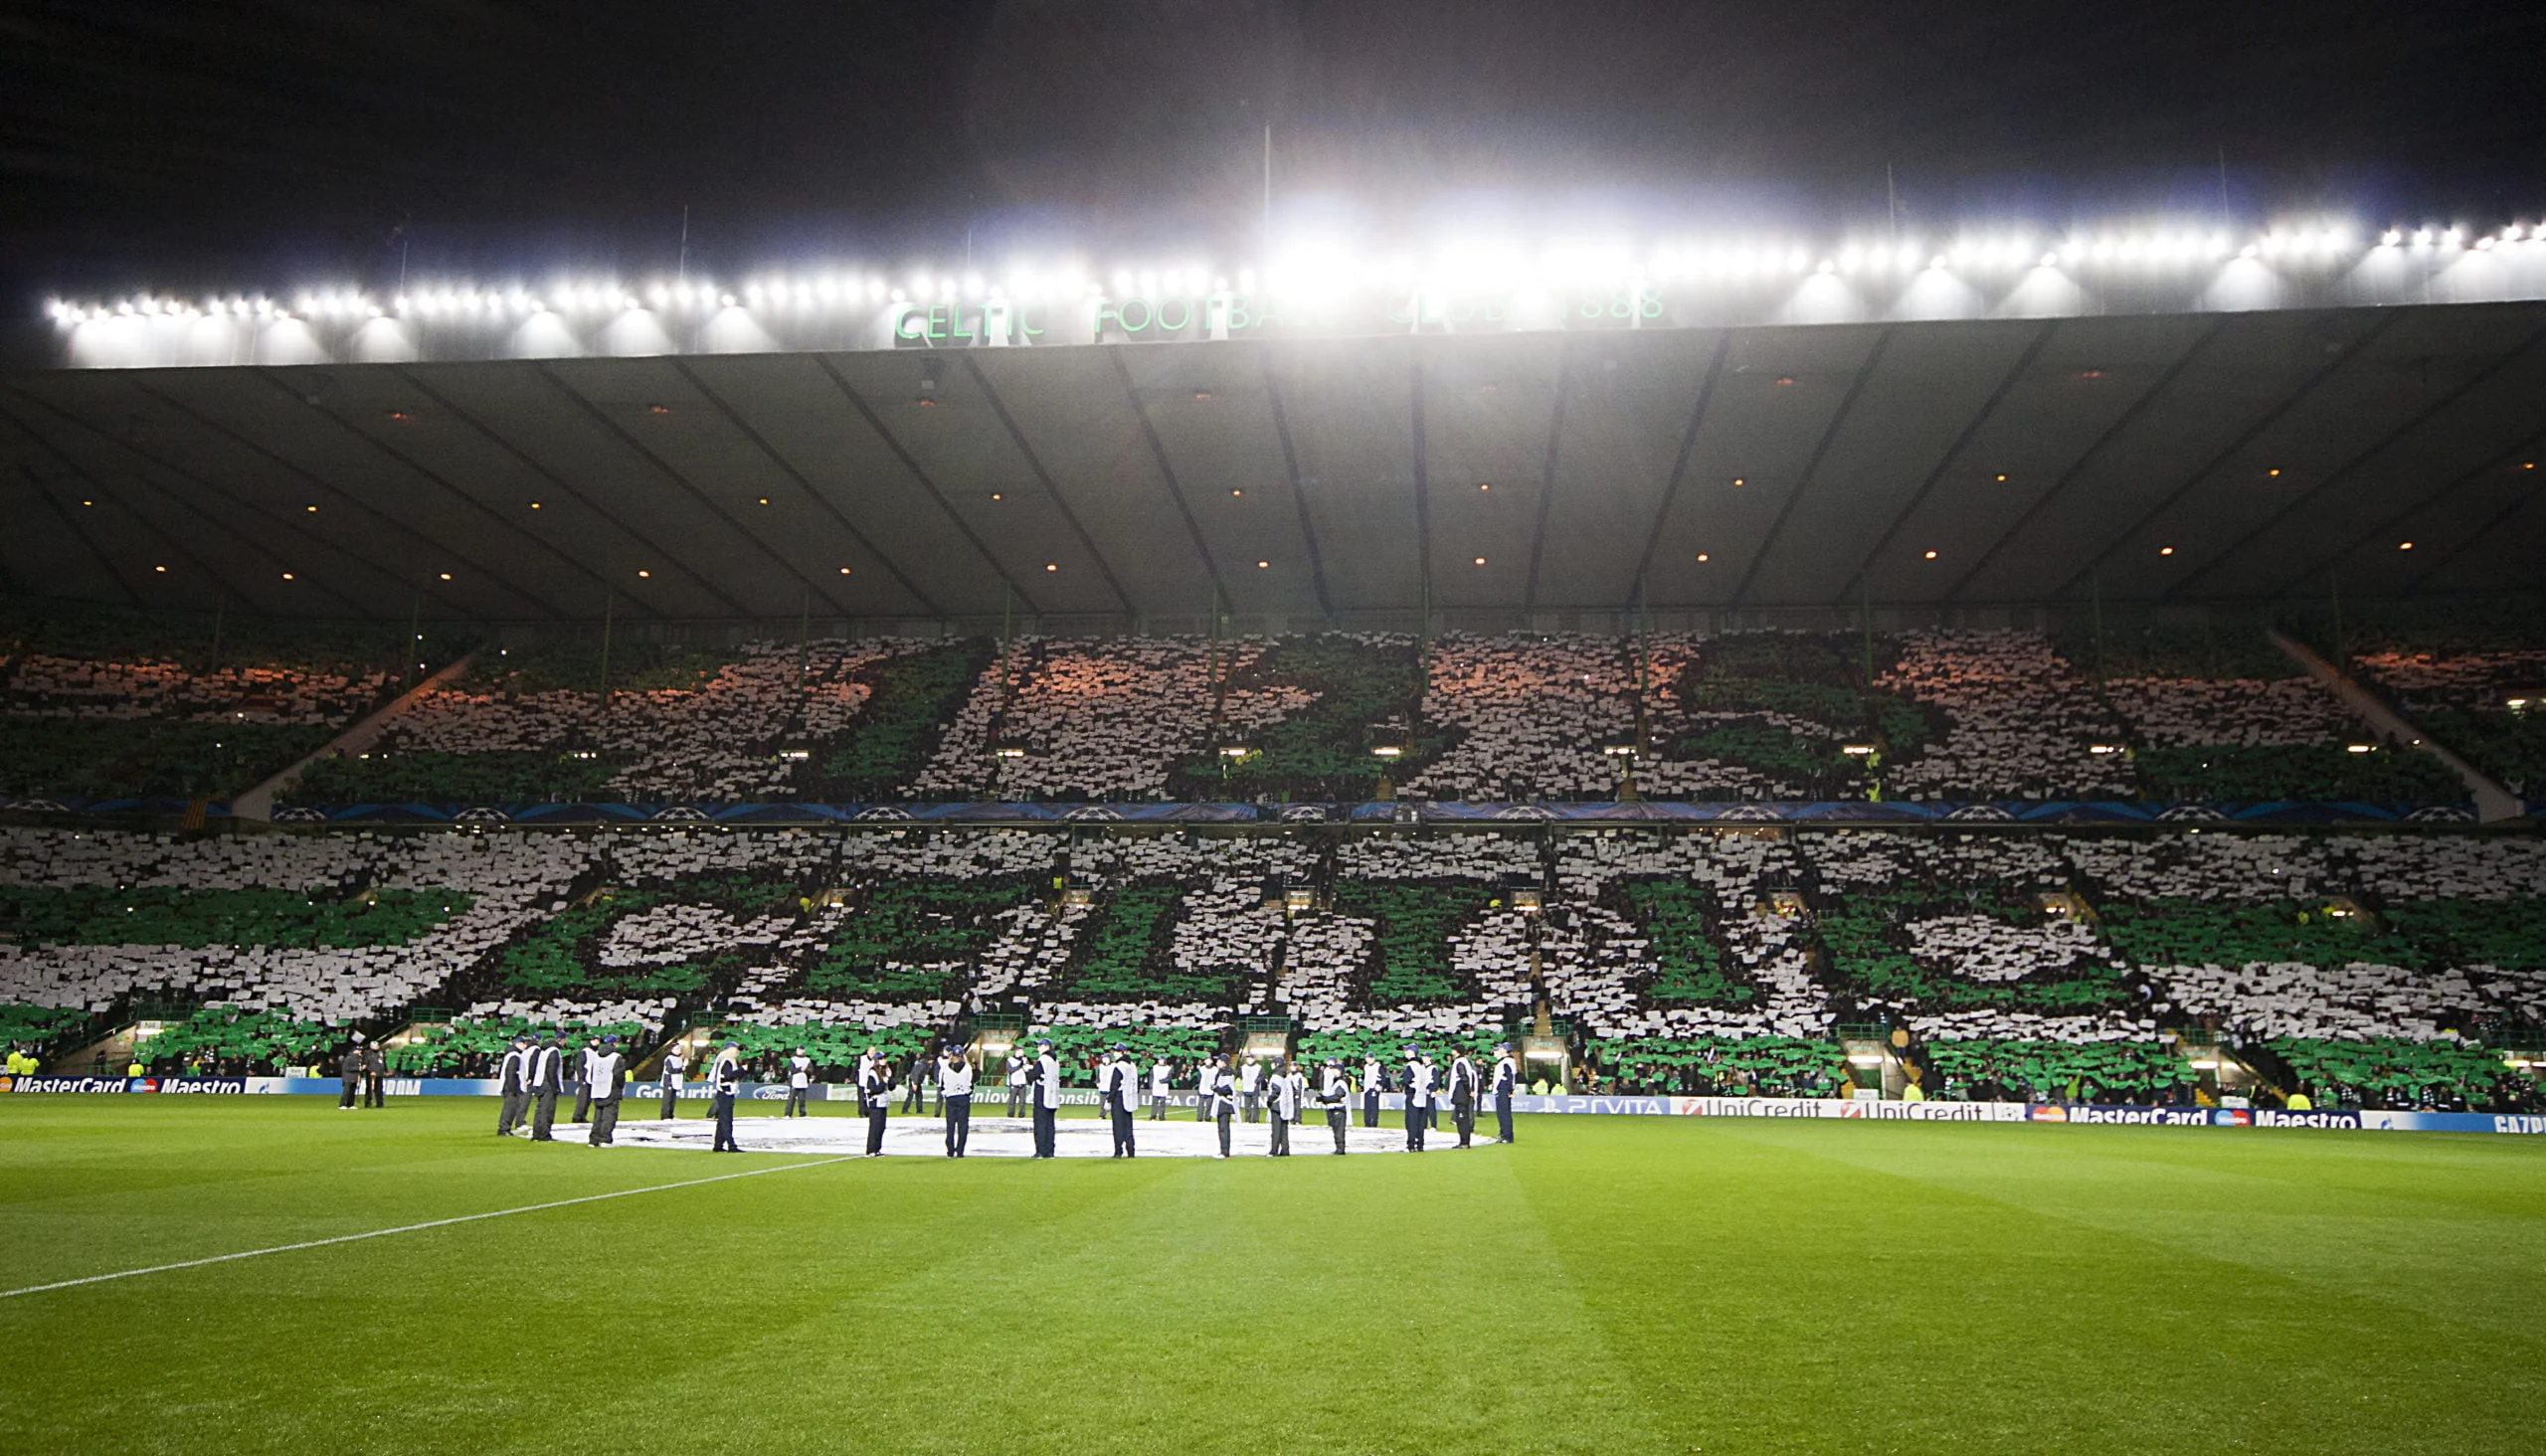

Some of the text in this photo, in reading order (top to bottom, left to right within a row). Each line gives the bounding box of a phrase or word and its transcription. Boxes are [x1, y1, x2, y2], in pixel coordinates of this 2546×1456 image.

[895, 301, 1044, 339] CELTIC
[14, 1077, 126, 1093] MasterCard
[160, 1079, 241, 1094] Maestro
[1707, 1099, 1822, 1117] UniCredit
[1866, 1102, 1982, 1121] UniCredit
[2070, 1107, 2208, 1126] MasterCard
[2255, 1110, 2357, 1129] Maestro
